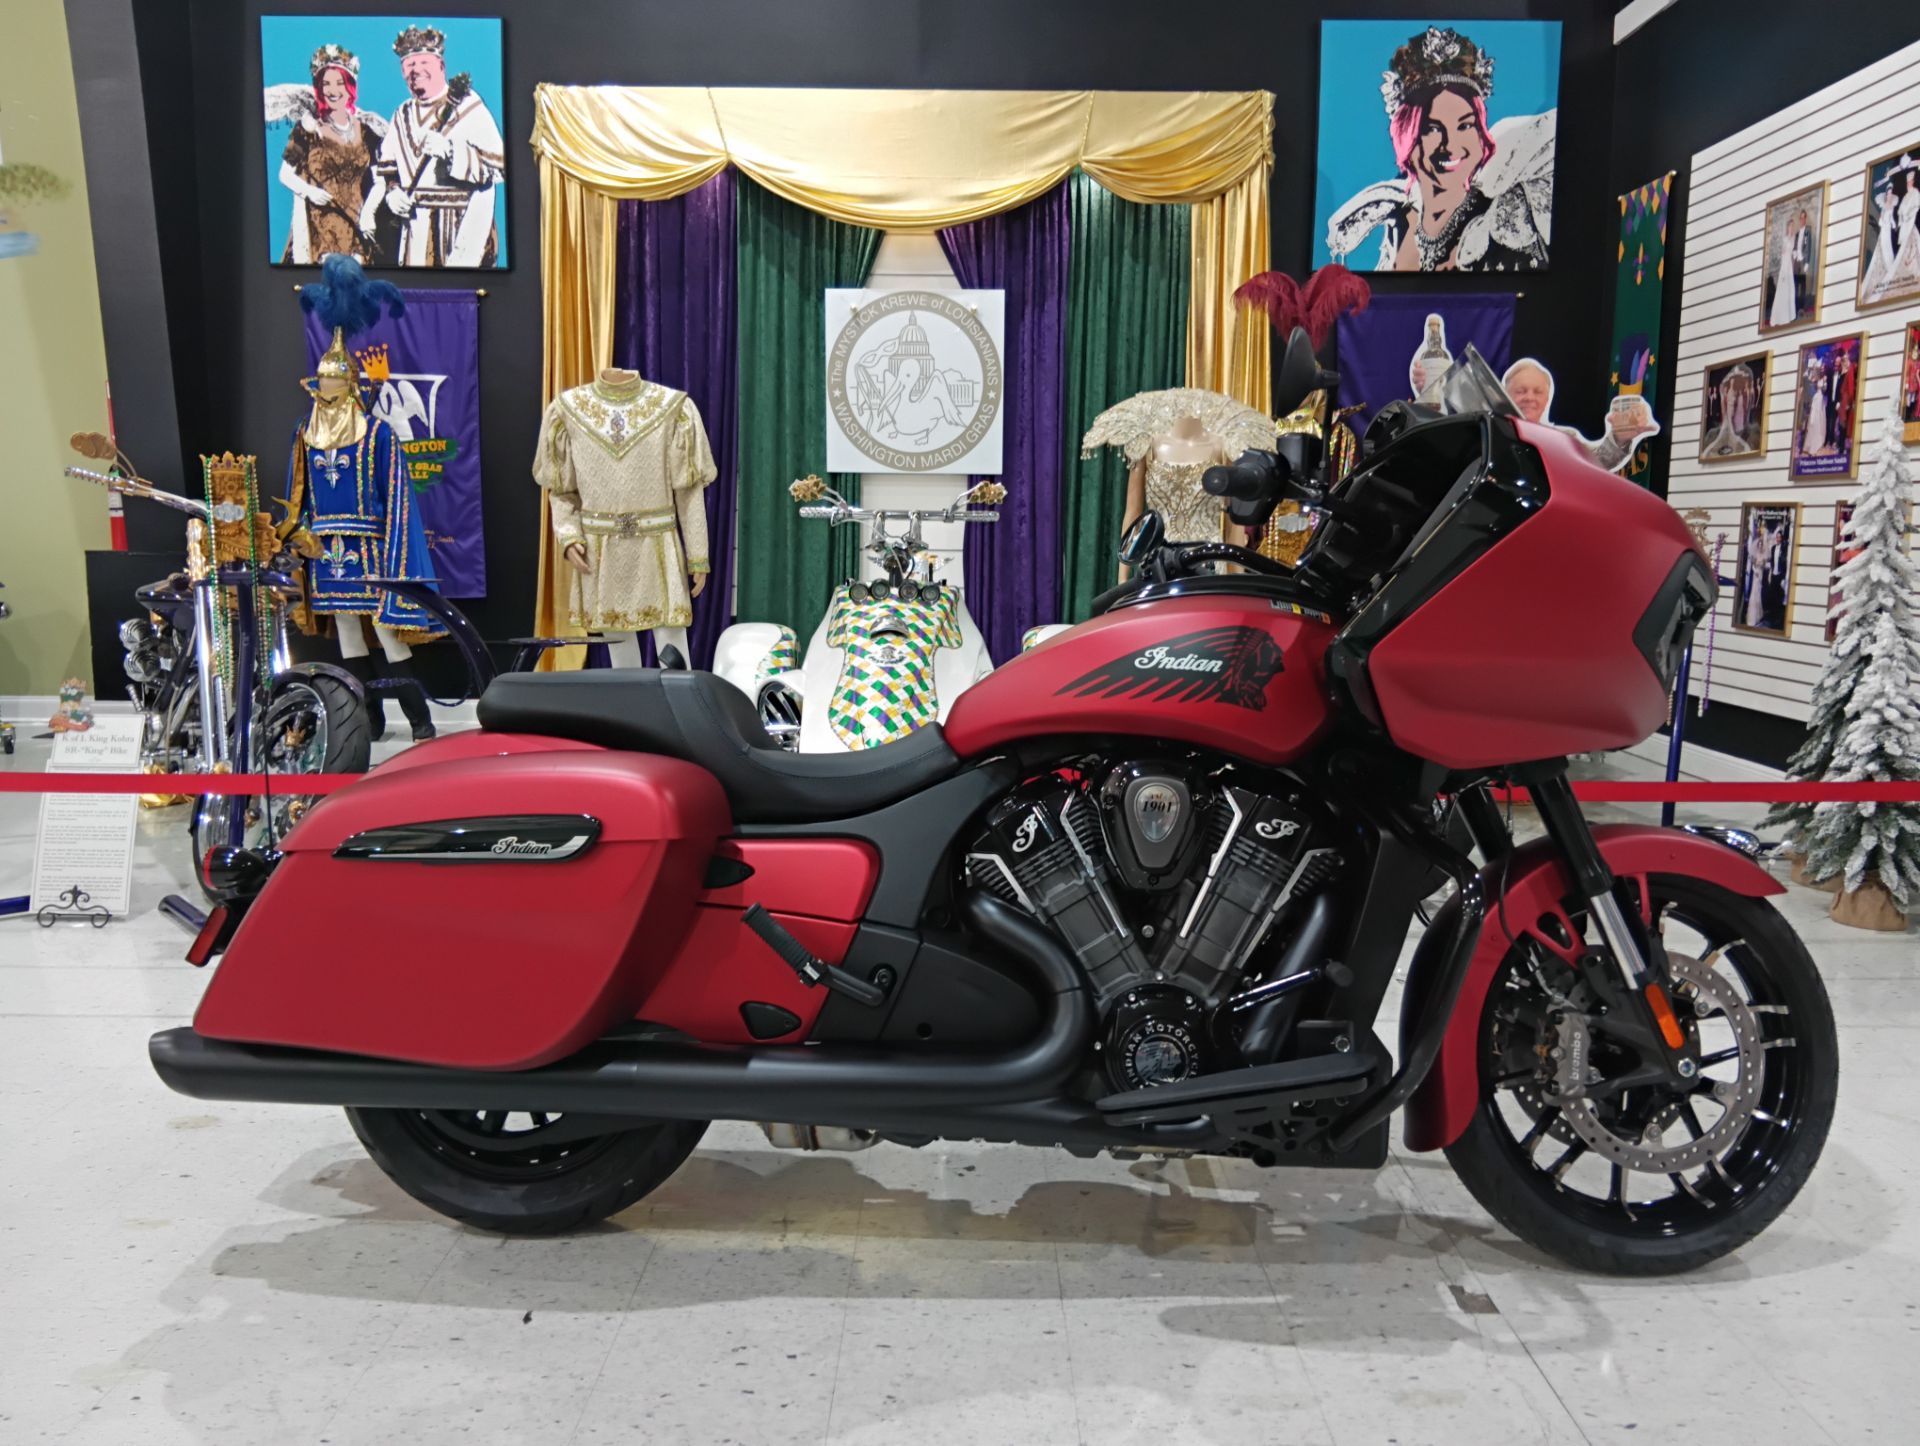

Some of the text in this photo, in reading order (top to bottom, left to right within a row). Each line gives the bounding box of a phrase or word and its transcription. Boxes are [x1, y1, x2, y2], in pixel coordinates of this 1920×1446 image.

[831, 293, 999, 386] The MYSTICK KREWE of LOUISIANIANS
[834, 401, 995, 469] WASHINGTON MARDI GRAS
[1134, 646, 1223, 672] Indian
[1143, 801, 1172, 813] 1901
[491, 836, 552, 856] Indian
[1125, 1033, 1143, 1083] INDIAN
[1145, 1023, 1199, 1076] MOTORCYCL
[1569, 1031, 1582, 1081] brembo
